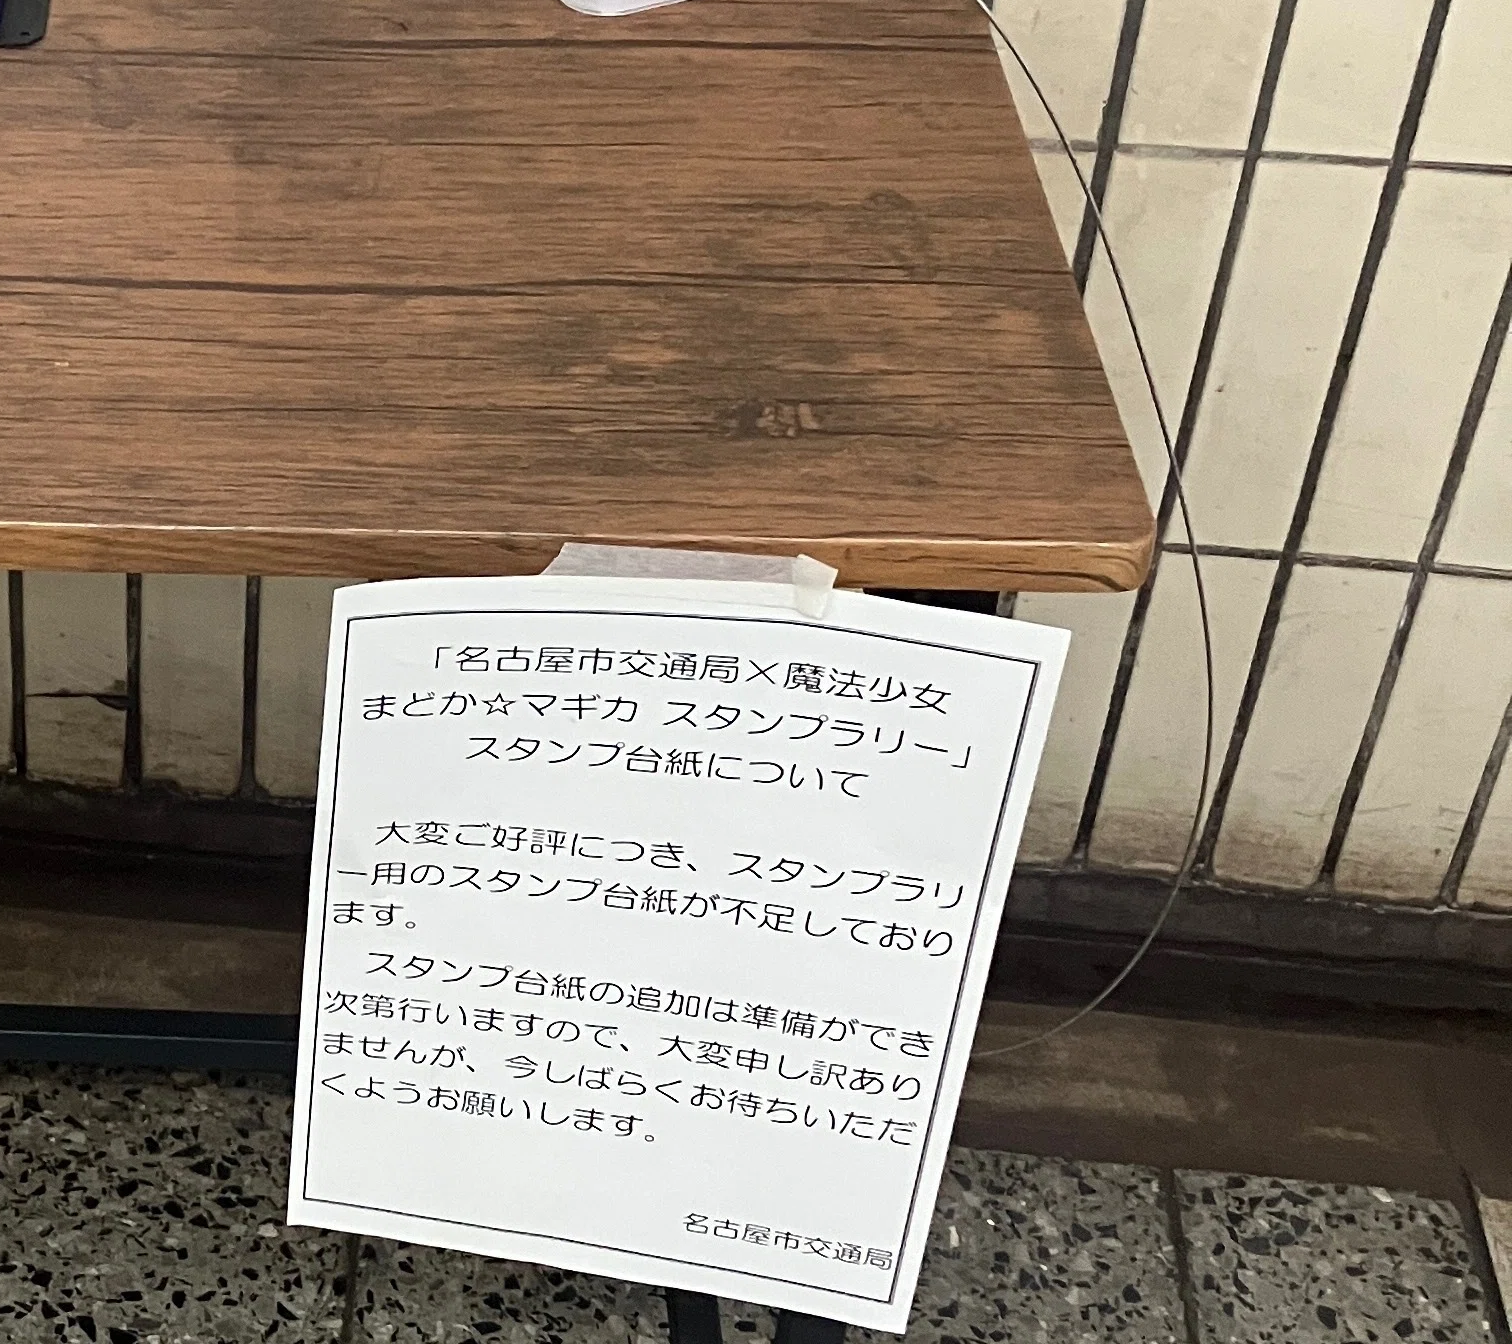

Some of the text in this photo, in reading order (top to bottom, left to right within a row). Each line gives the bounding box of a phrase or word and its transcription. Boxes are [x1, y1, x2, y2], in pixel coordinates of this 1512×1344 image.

[434, 645, 952, 715] 「名古屋市交通局×魔法少女
[362, 691, 972, 769] まどか☆マギカ スタンプラリー」
[465, 736, 870, 798] スタンプ台紙について
[374, 820, 964, 910] 大変ご好評につき、スタンプラリ
[332, 900, 417, 930] ます。
[336, 861, 953, 957] ー用のスタンプ台紙が不足しており
[365, 951, 935, 1058] スタンプ台紙の追加は準備ができ
[323, 990, 921, 1101] 次第行いますので、大変申し訳あり
[320, 1072, 655, 1143] くようお願いします。
[322, 1031, 918, 1146] ませんが、今しばらくお待ちいただ
[682, 1211, 894, 1271] 名古屋市交通局
